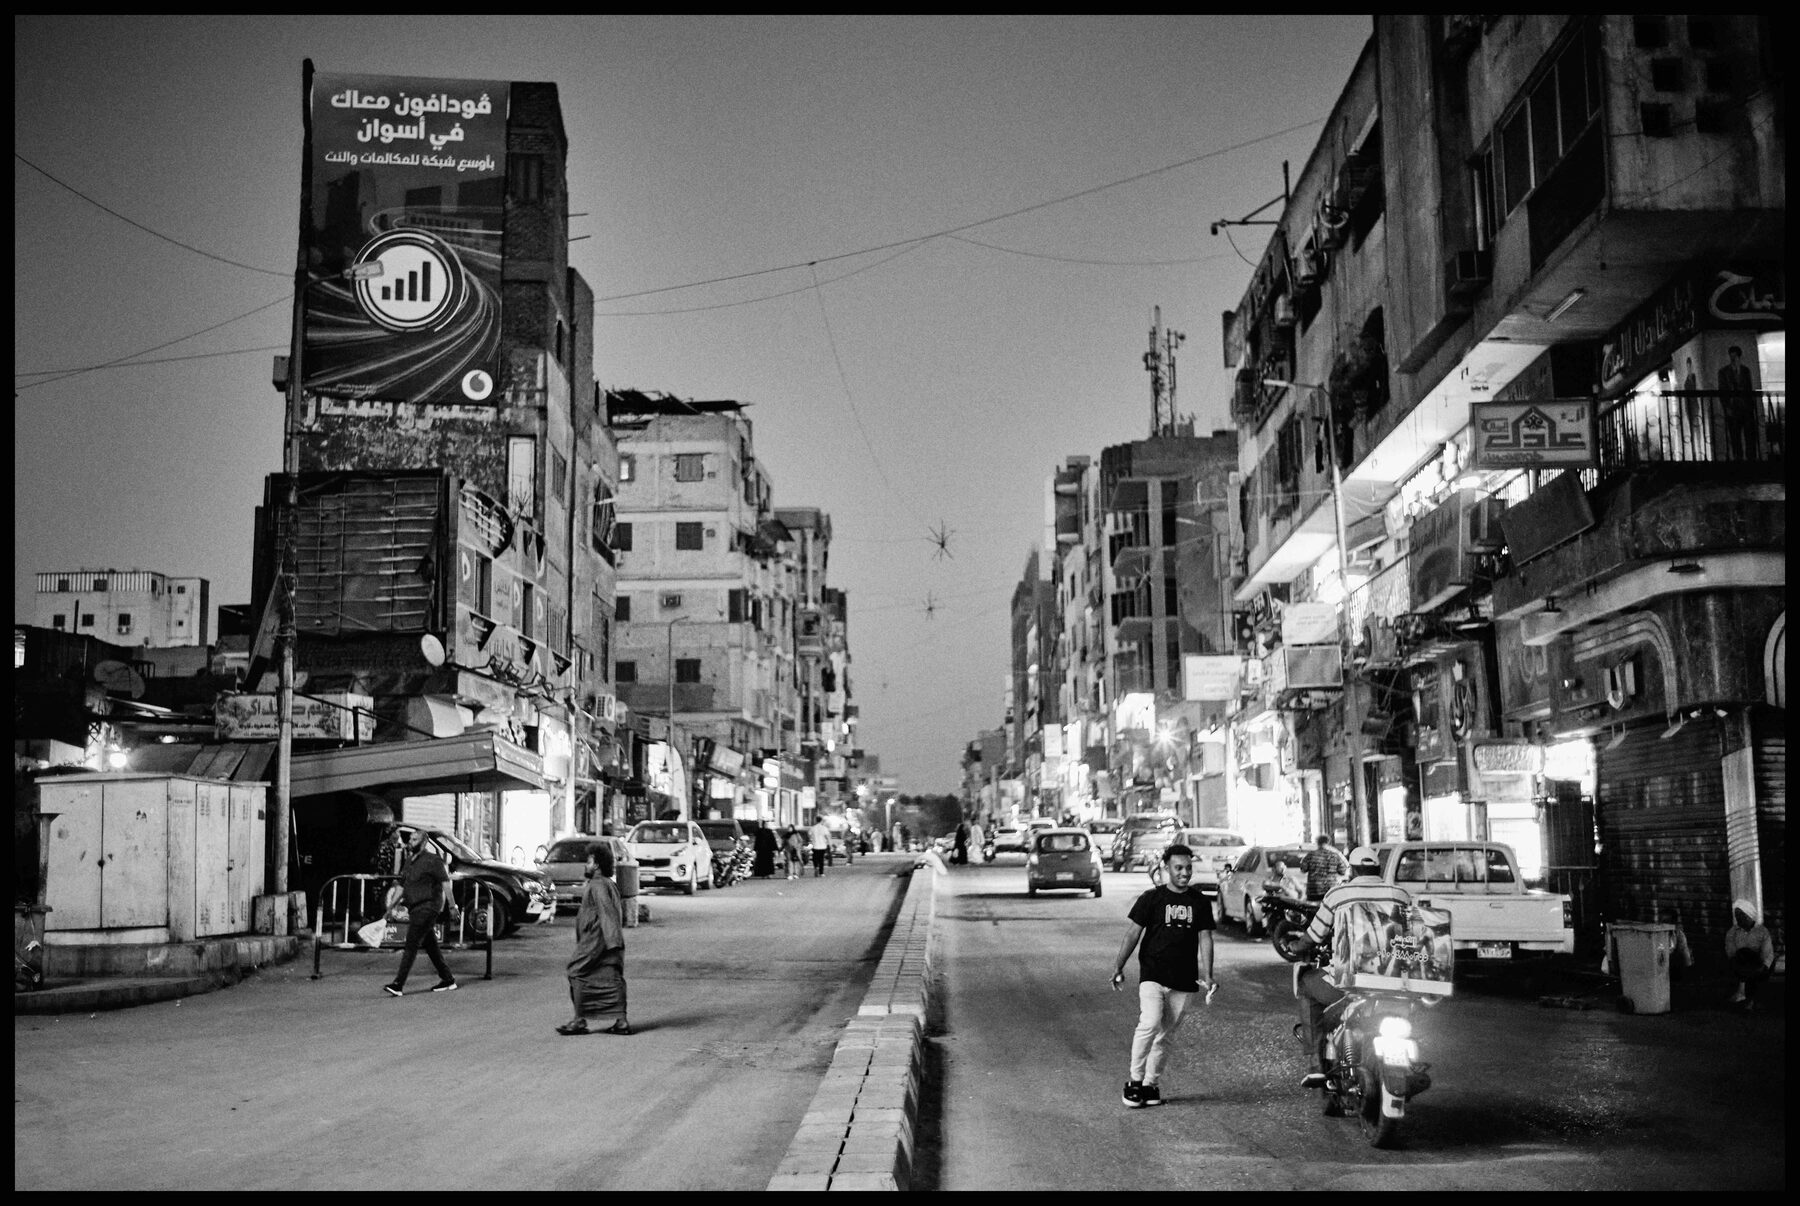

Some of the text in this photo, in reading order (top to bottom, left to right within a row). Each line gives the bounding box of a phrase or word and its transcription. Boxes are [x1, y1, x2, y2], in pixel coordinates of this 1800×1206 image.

[330, 89, 391, 110] معاك
[356, 116, 465, 151] في أسوان
[324, 151, 496, 172] بأوسع شبكة للمكالمات والنت
